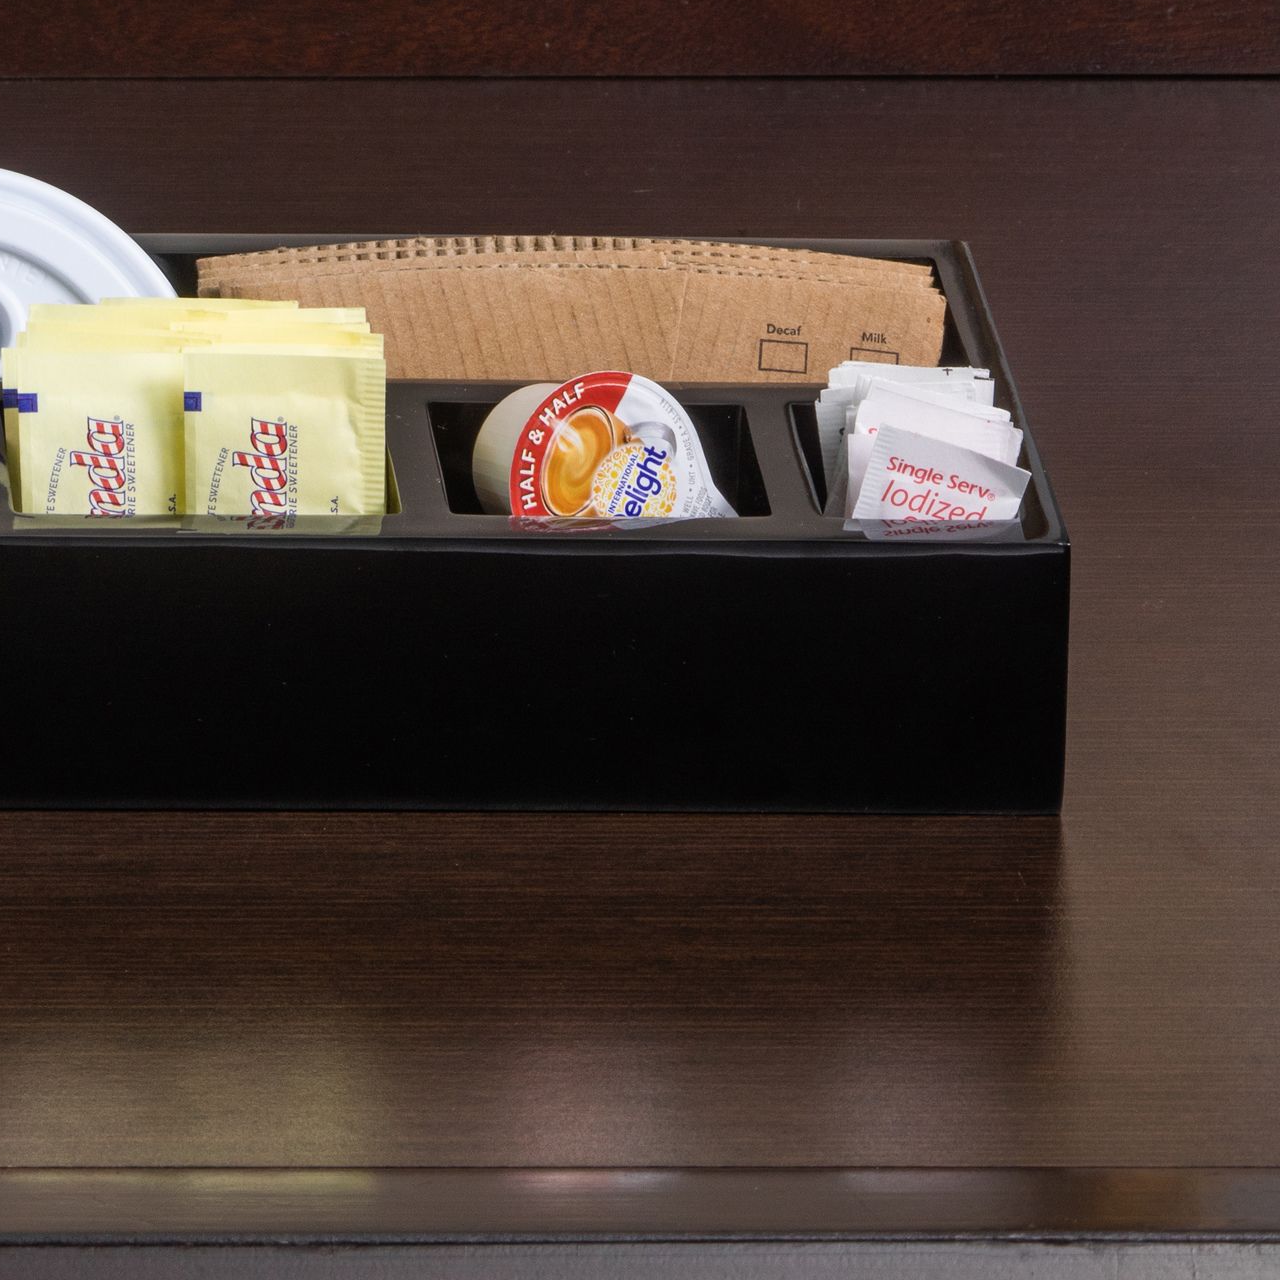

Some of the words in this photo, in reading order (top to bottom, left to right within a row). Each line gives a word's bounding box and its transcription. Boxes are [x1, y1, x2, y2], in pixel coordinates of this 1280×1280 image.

[766, 323, 801, 337] Decaf
[861, 332, 888, 345] Milk
[539, 381, 587, 426] HALF
[126, 423, 136, 493] SWEETENER
[289, 424, 299, 496] SWEETENER
[528, 429, 546, 446] &
[47, 447, 67, 503] SWEETENER
[209, 447, 229, 505] SWEETENER
[520, 449, 538, 510] HALF
[608, 453, 640, 515] INTERNATIONAL
[615, 445, 666, 518] elight
[886, 456, 944, 485] Single
[947, 474, 990, 501] Serv
